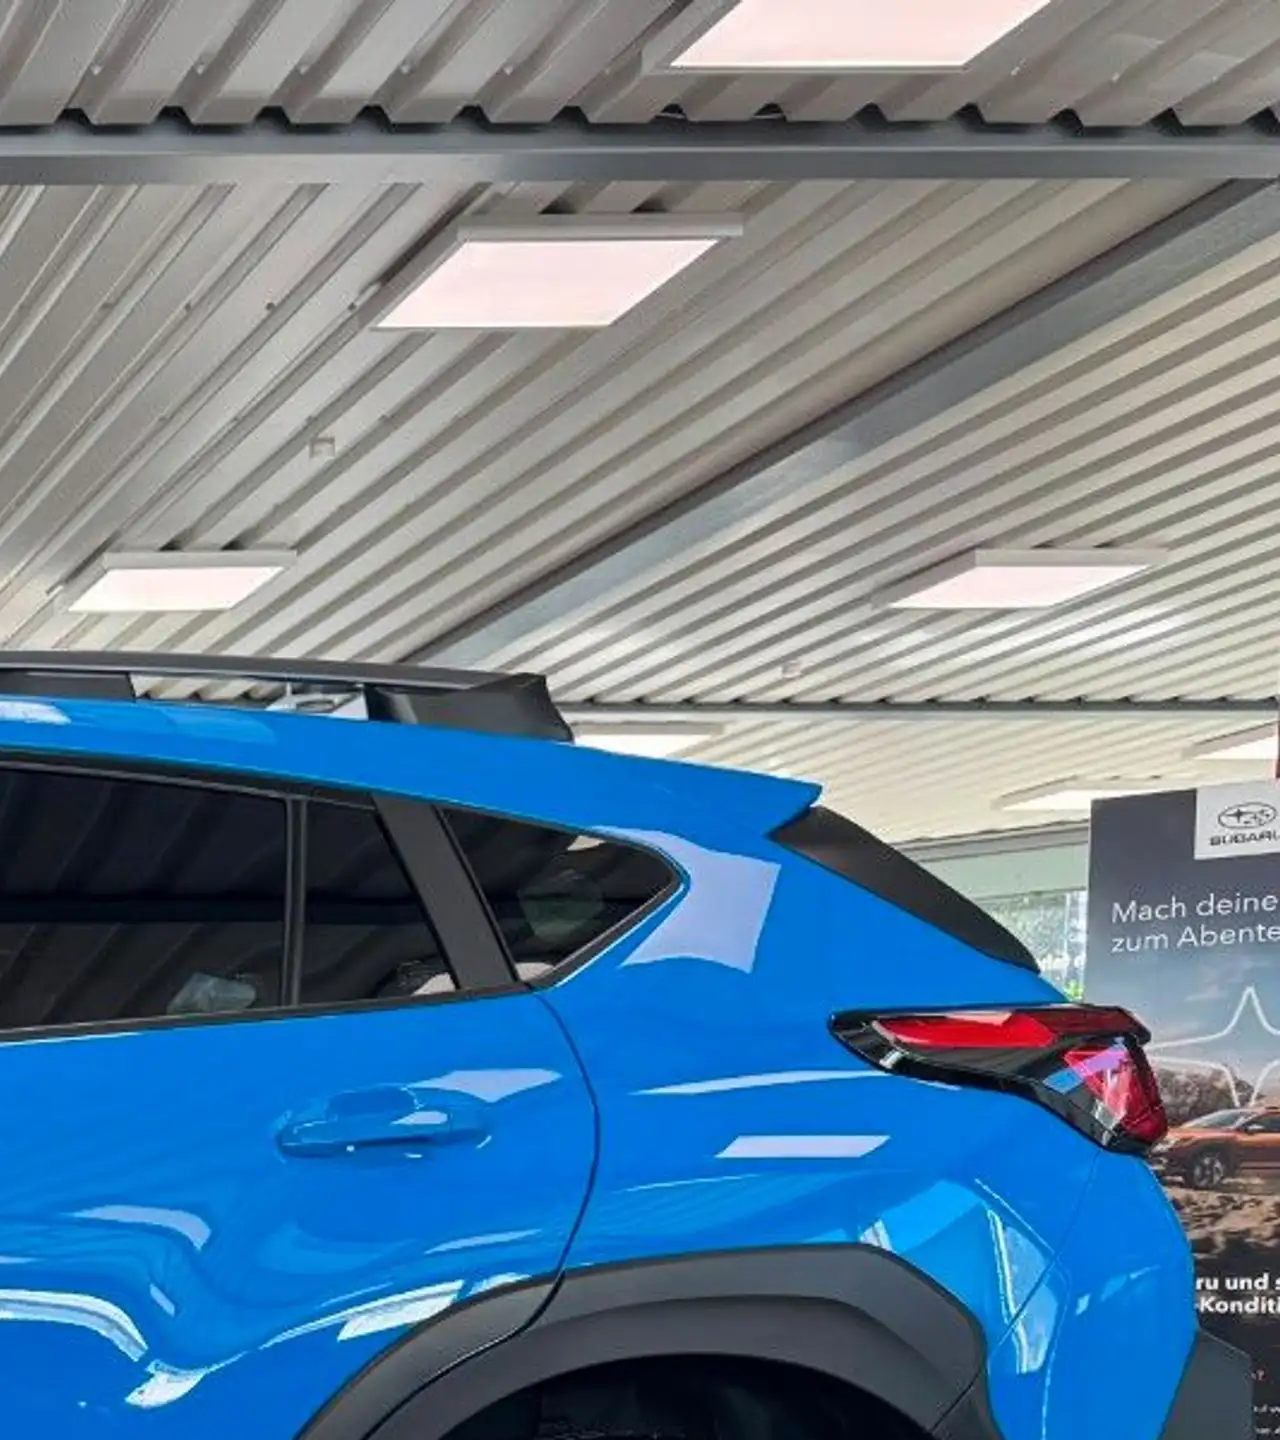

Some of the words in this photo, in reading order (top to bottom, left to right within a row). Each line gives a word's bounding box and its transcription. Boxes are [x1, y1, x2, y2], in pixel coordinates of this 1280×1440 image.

[1111, 895, 1186, 923] Mach
[1195, 893, 1279, 916] deine
[1111, 933, 1169, 953] zum
[1176, 924, 1280, 949] Abente
[1225, 1272, 1269, 1291] und
